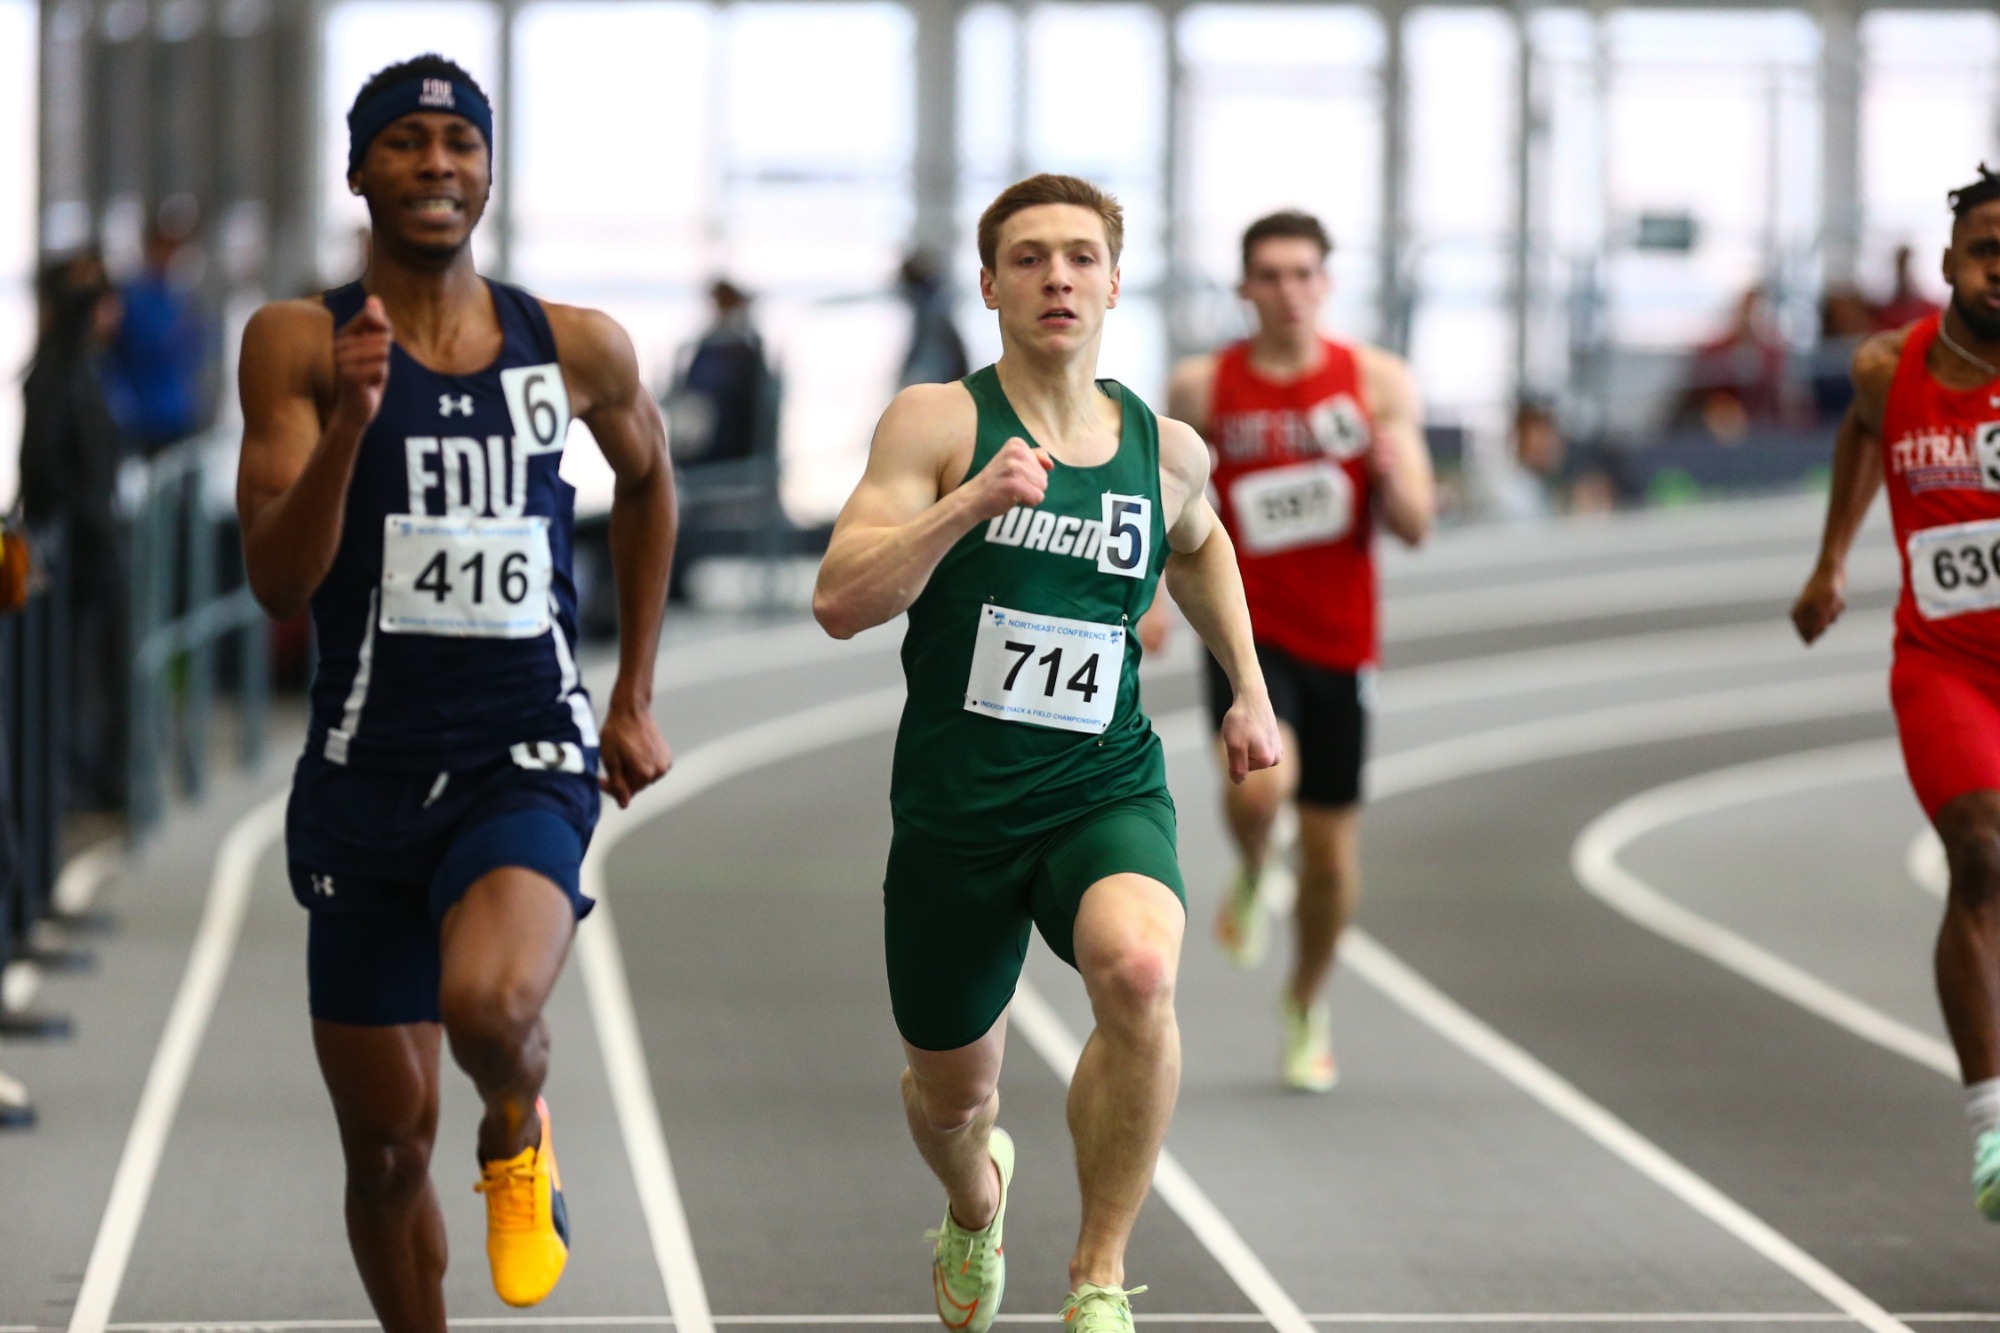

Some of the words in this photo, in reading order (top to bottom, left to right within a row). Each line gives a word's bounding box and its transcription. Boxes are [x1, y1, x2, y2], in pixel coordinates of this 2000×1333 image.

[522, 373, 558, 447] 6
[404, 435, 528, 517] FDU
[984, 505, 1103, 561] WAGN
[1106, 499, 1142, 570] 5
[413, 550, 529, 605] 416
[1008, 619, 1056, 632] NORTHEAST
[1057, 626, 1107, 641] CONFERENCE
[1003, 640, 1100, 703] 714
[980, 700, 1005, 712] INDOOR
[1006, 706, 1026, 715] TRACK
[1033, 709, 1052, 719] FIELD
[1053, 713, 1102, 726] CHAMPIONSHIPS
